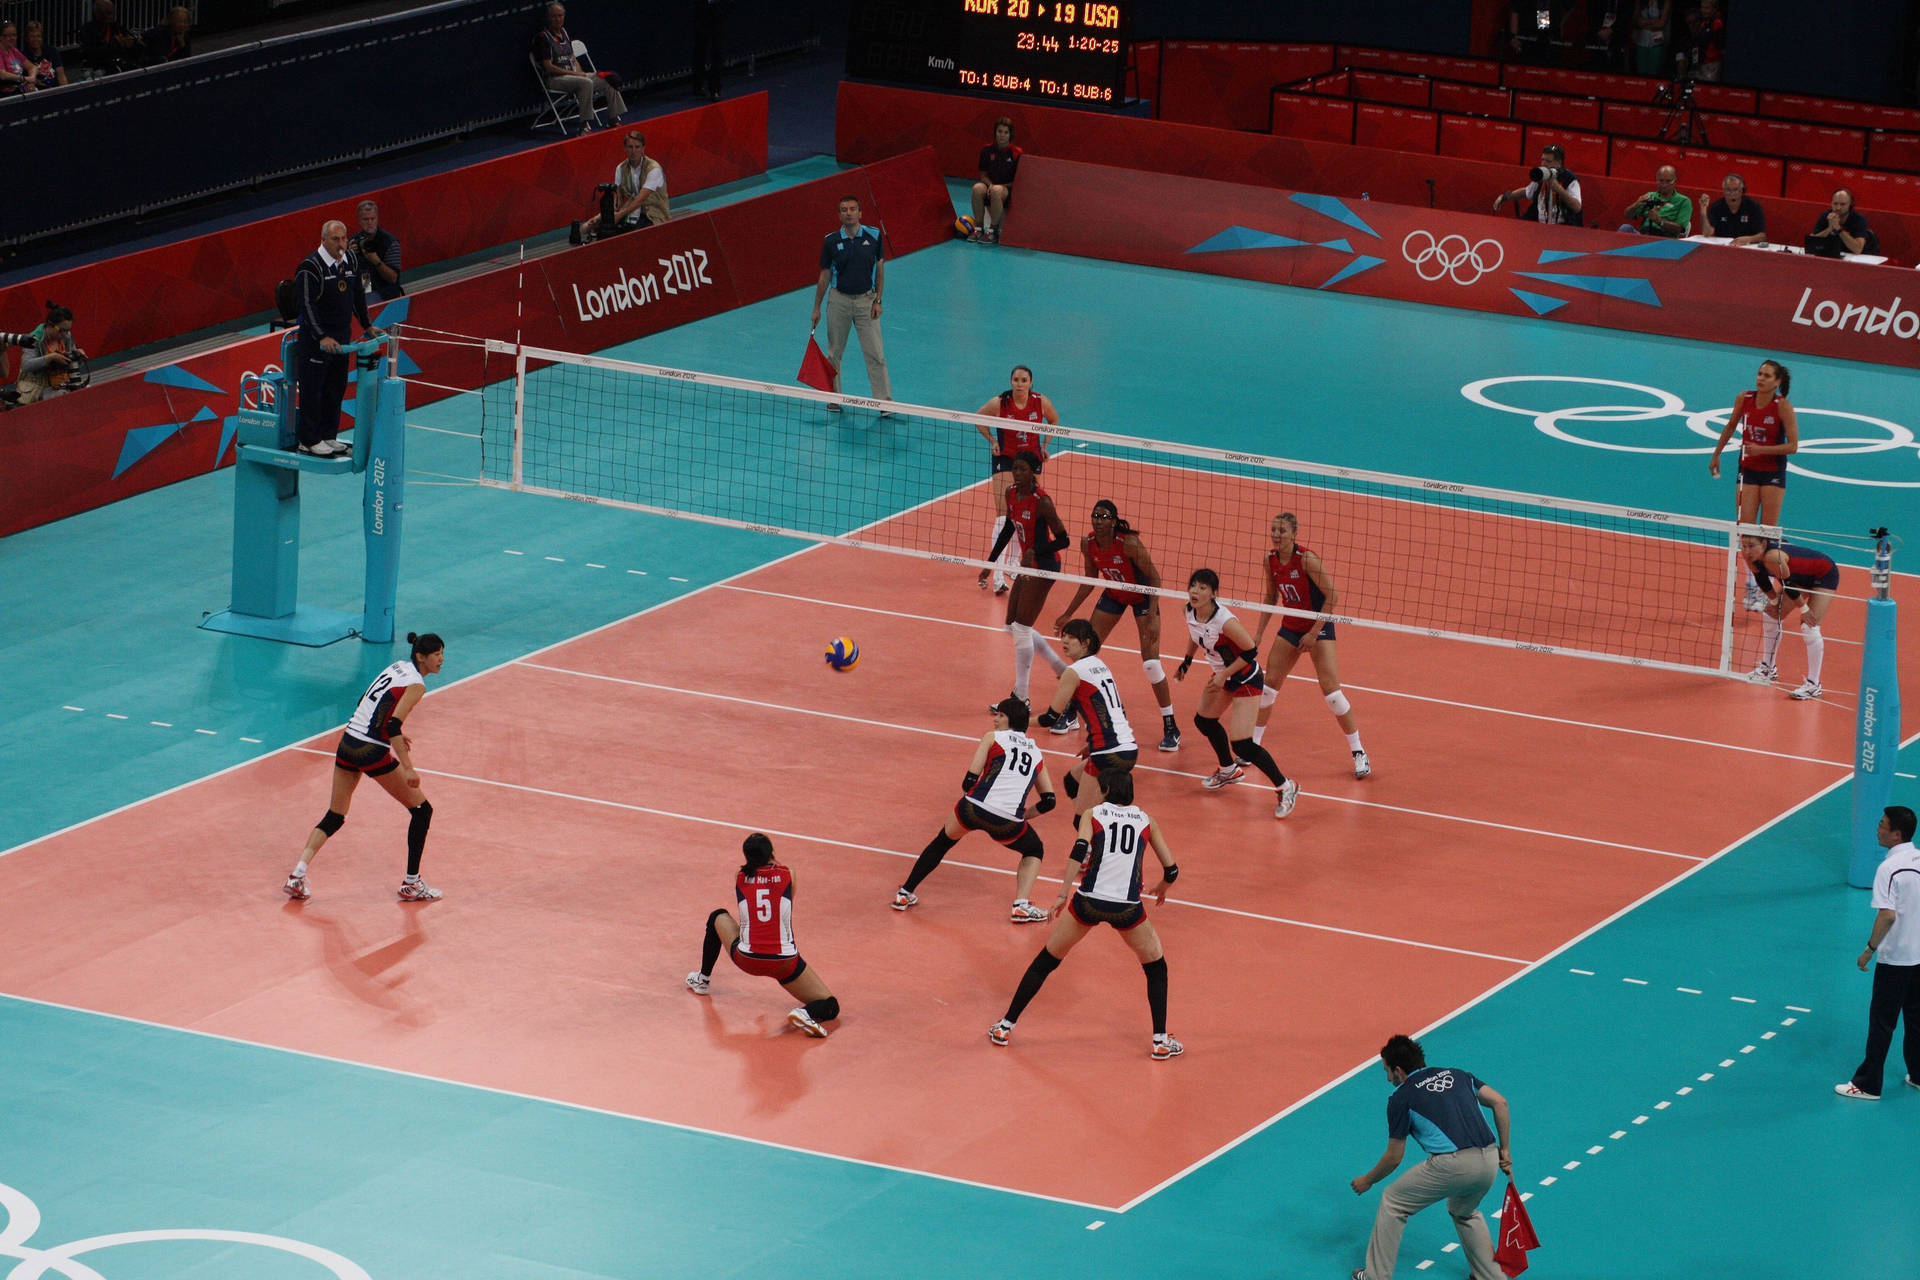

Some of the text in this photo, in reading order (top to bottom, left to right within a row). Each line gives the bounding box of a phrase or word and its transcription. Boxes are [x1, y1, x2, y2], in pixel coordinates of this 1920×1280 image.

[1007, 0, 1029, 18] 20
[1054, 3, 1075, 23] 19
[1084, 3, 1119, 28] USA
[1017, 32, 1059, 52] 23:44
[928, 55, 955, 70] Km/h
[959, 70, 1112, 101] TO:1 SUB:4 TO:1 SUB:6
[572, 248, 712, 321] London 2012
[1791, 287, 1920, 340] Londo
[659, 368, 681, 378] London
[842, 397, 865, 406] London
[239, 416, 261, 426] London
[1031, 425, 1055, 434] London
[1225, 453, 1249, 462] London
[372, 457, 386, 536] London 2012
[1423, 481, 1448, 491] London
[1627, 510, 1651, 520] London
[1516, 643, 1539, 652] London
[365, 673, 393, 703] 12
[1101, 678, 1121, 709] 17
[1862, 687, 1879, 772] London 2012
[1009, 747, 1032, 776] 19
[1109, 821, 1135, 855] 10
[756, 888, 772, 922] 5
[1415, 1074, 1438, 1089] London
